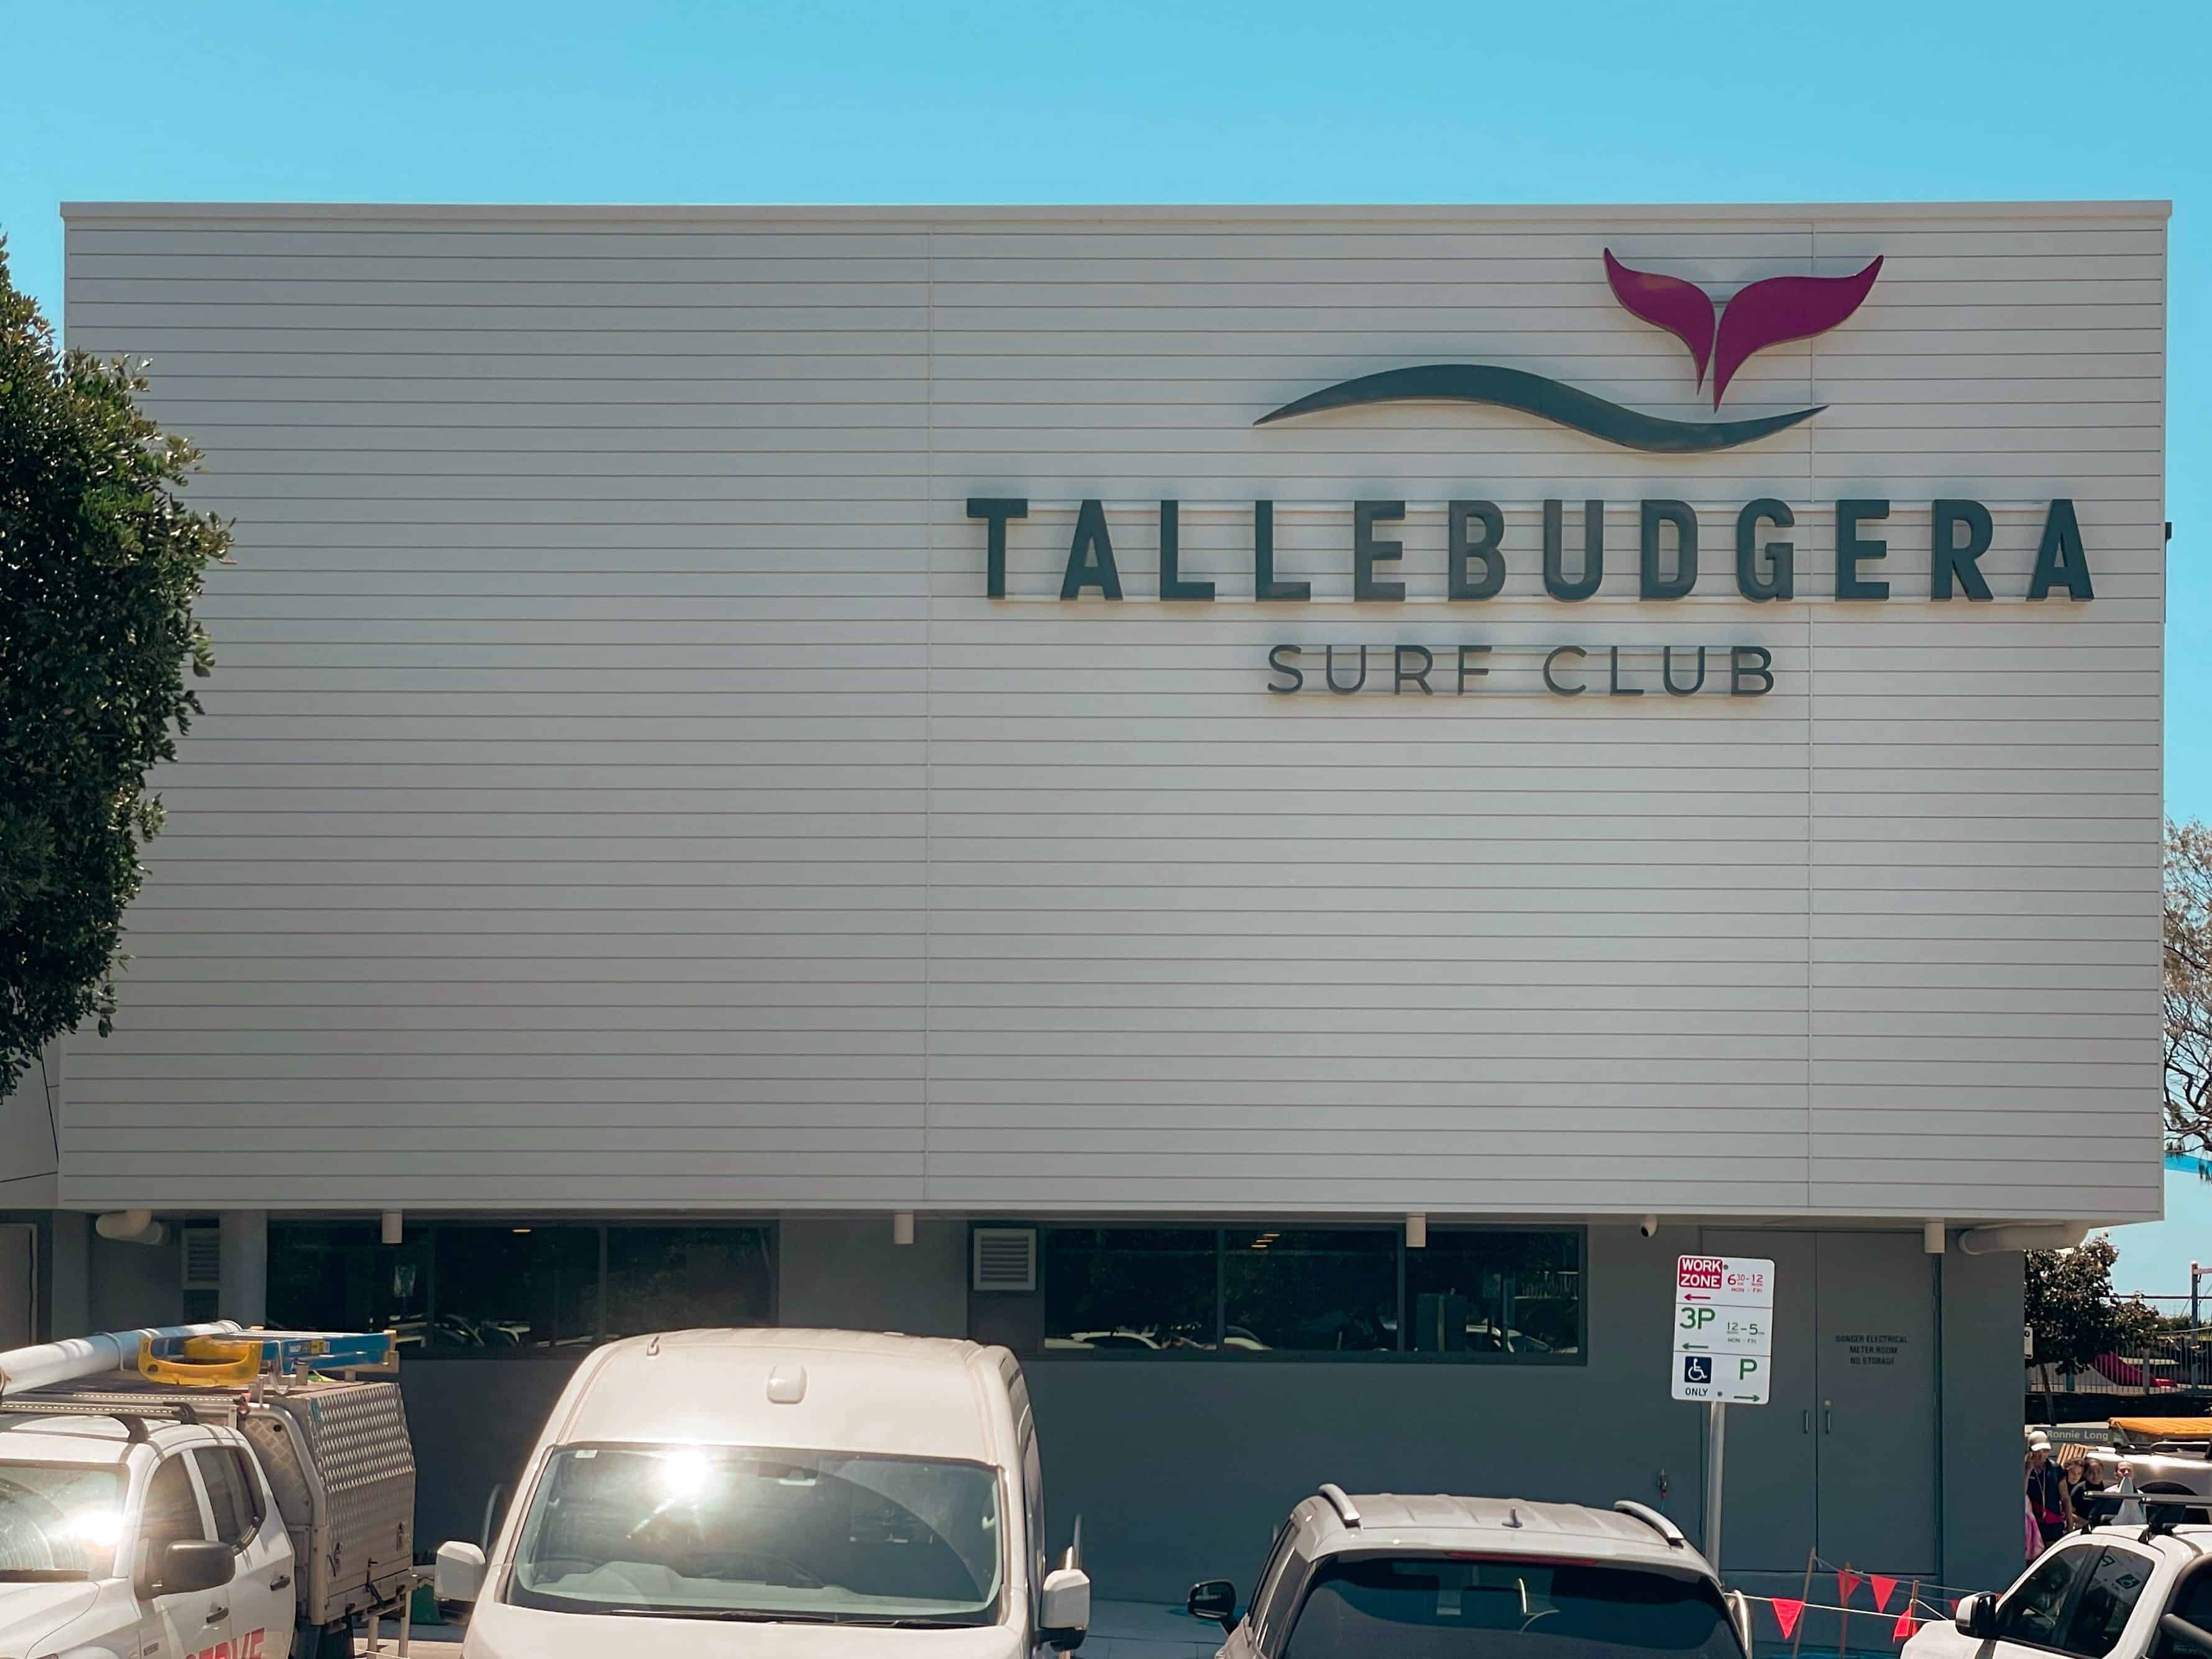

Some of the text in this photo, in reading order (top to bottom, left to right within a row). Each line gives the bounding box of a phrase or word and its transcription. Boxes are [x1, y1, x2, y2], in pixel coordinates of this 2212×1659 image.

[966, 498, 2095, 602] TALLEBUDGERA
[1267, 644, 1774, 697] SURF CLUB
[1682, 1258, 1721, 1272] WORK
[1680, 1274, 1720, 1287] ZONE
[1679, 1307, 1715, 1330] 3P
[1866, 1335, 1908, 1343] ELECTRICAL
[1863, 1357, 1894, 1365] STORAGE
[1740, 1358, 1758, 1380] P
[1685, 1387, 1708, 1396] ONLY
[2047, 1430, 2108, 1441] Ronnie Long
